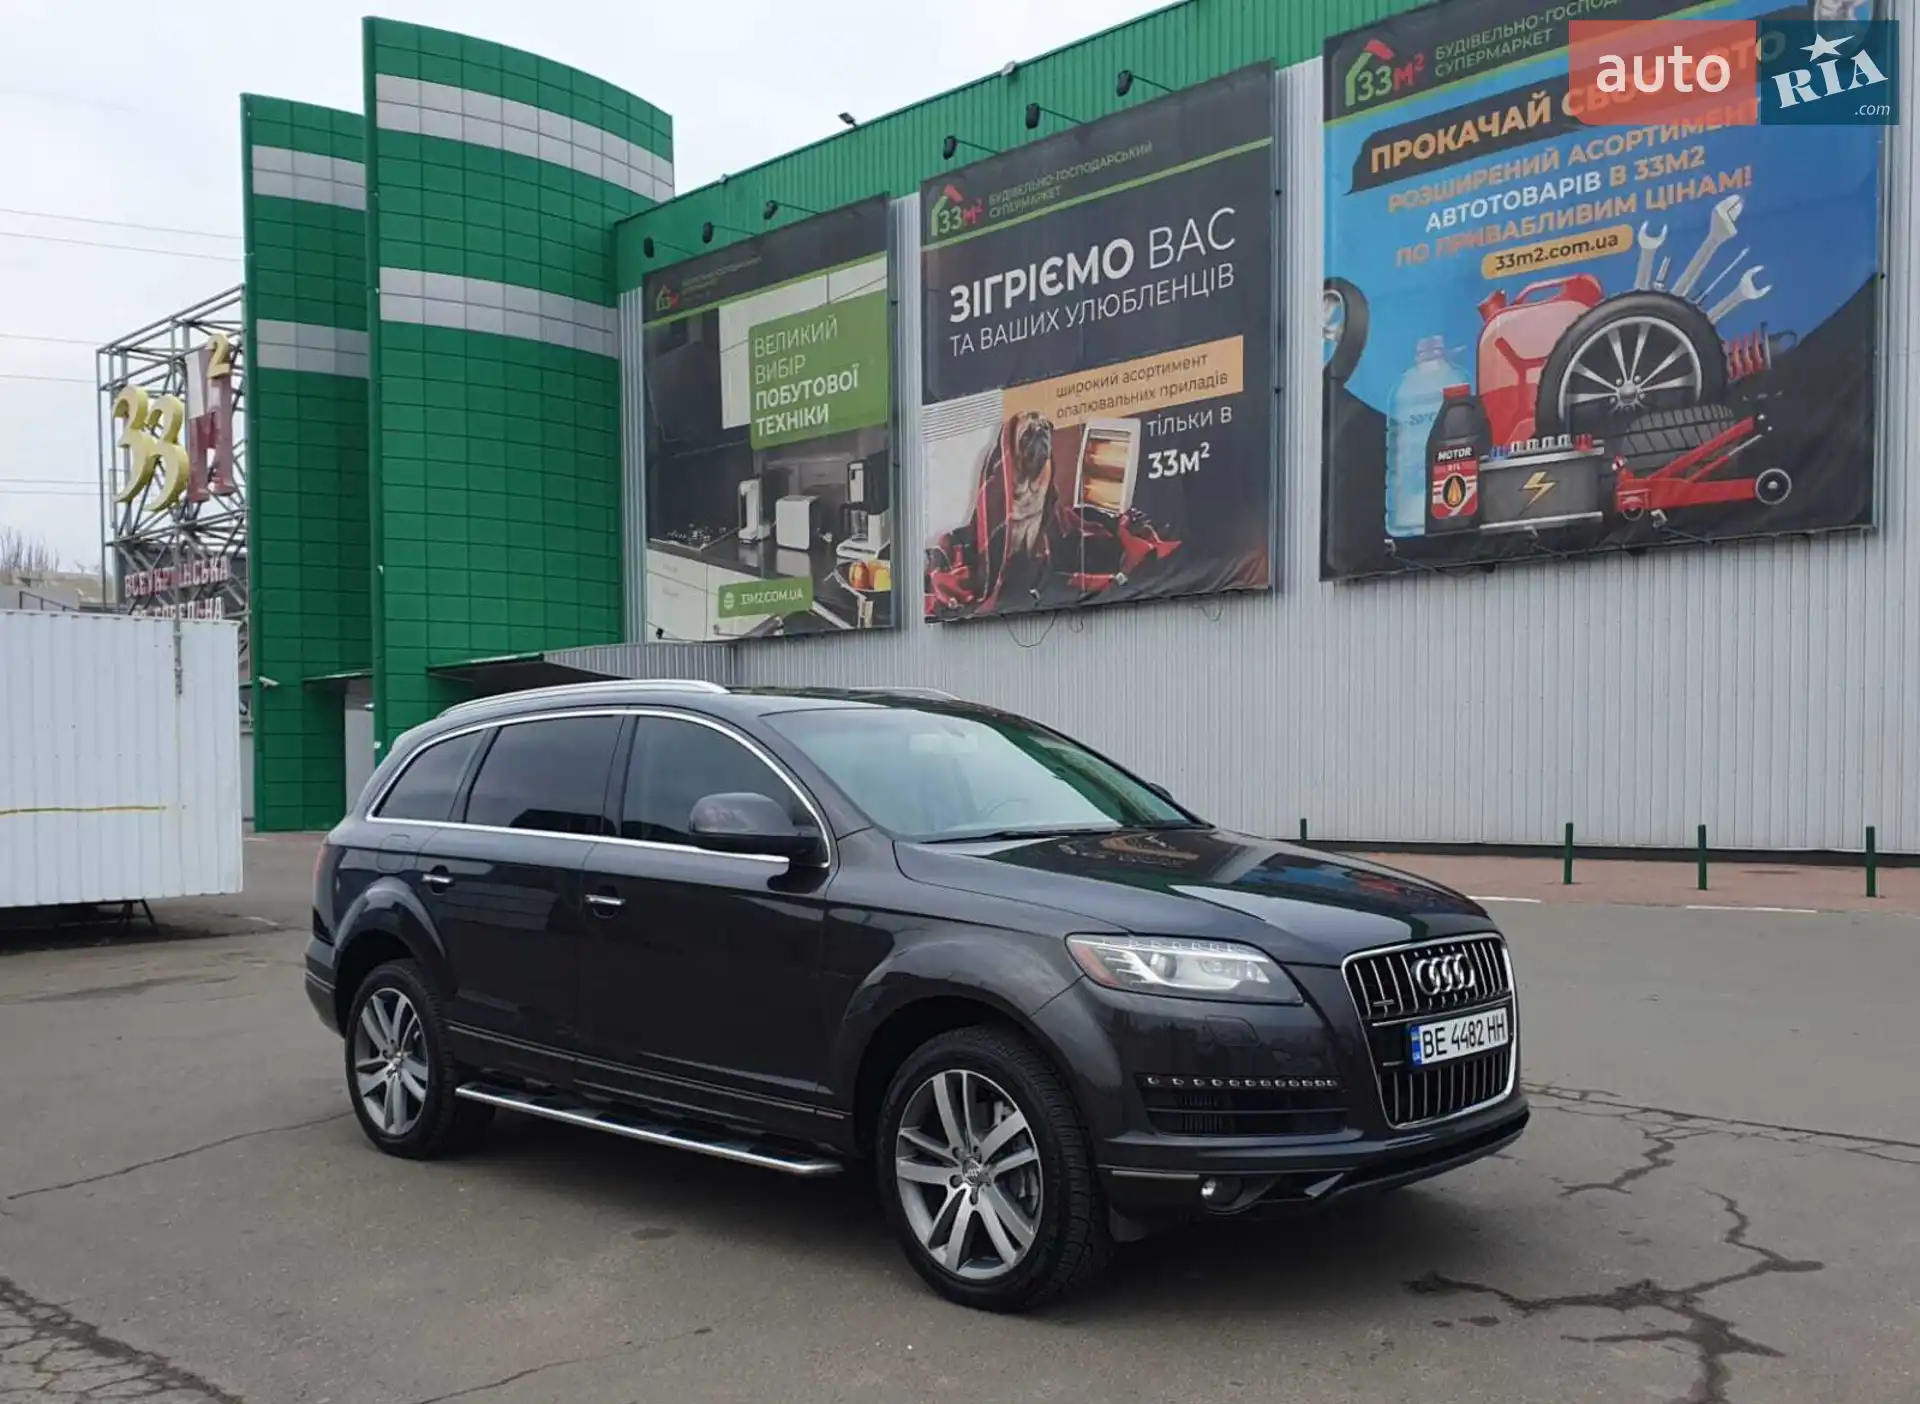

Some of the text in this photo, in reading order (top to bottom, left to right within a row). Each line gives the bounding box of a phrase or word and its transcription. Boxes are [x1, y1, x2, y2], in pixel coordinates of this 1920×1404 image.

[1435, 28, 1552, 78] СУПЕРМАРКЕТ
[1371, 91, 1551, 174] ПРОКАЧАЙ
[1388, 146, 1560, 213] РОЗШИРЕНИЙ
[1425, 171, 1601, 233] АВТОТОВАРІВ
[1609, 164, 1627, 187] В
[1395, 165, 1752, 268] ПО ПРИВАБЛИВИМ ЦІНАМ!
[949, 207, 1236, 323] ЗІГРІЄМО ВАС
[1494, 233, 1619, 271] 33m2.com.ua
[950, 262, 1235, 357] ТА ВАШИХ УЛЮБЛЕНЦІВ
[754, 313, 838, 358] ВЕЛИКИЙ
[755, 354, 806, 385] ВИБІР
[755, 363, 860, 411] ПОБУТОВОЇ
[1056, 353, 1208, 398] широкий асортимент
[1056, 370, 1228, 419] опалювальних приладів
[756, 403, 829, 437] ТЕХНІКИ
[1147, 409, 1213, 437] тільки
[1437, 447, 1472, 462] MOTOR
[1422, 1012, 1506, 1059] BE 4482 HH
